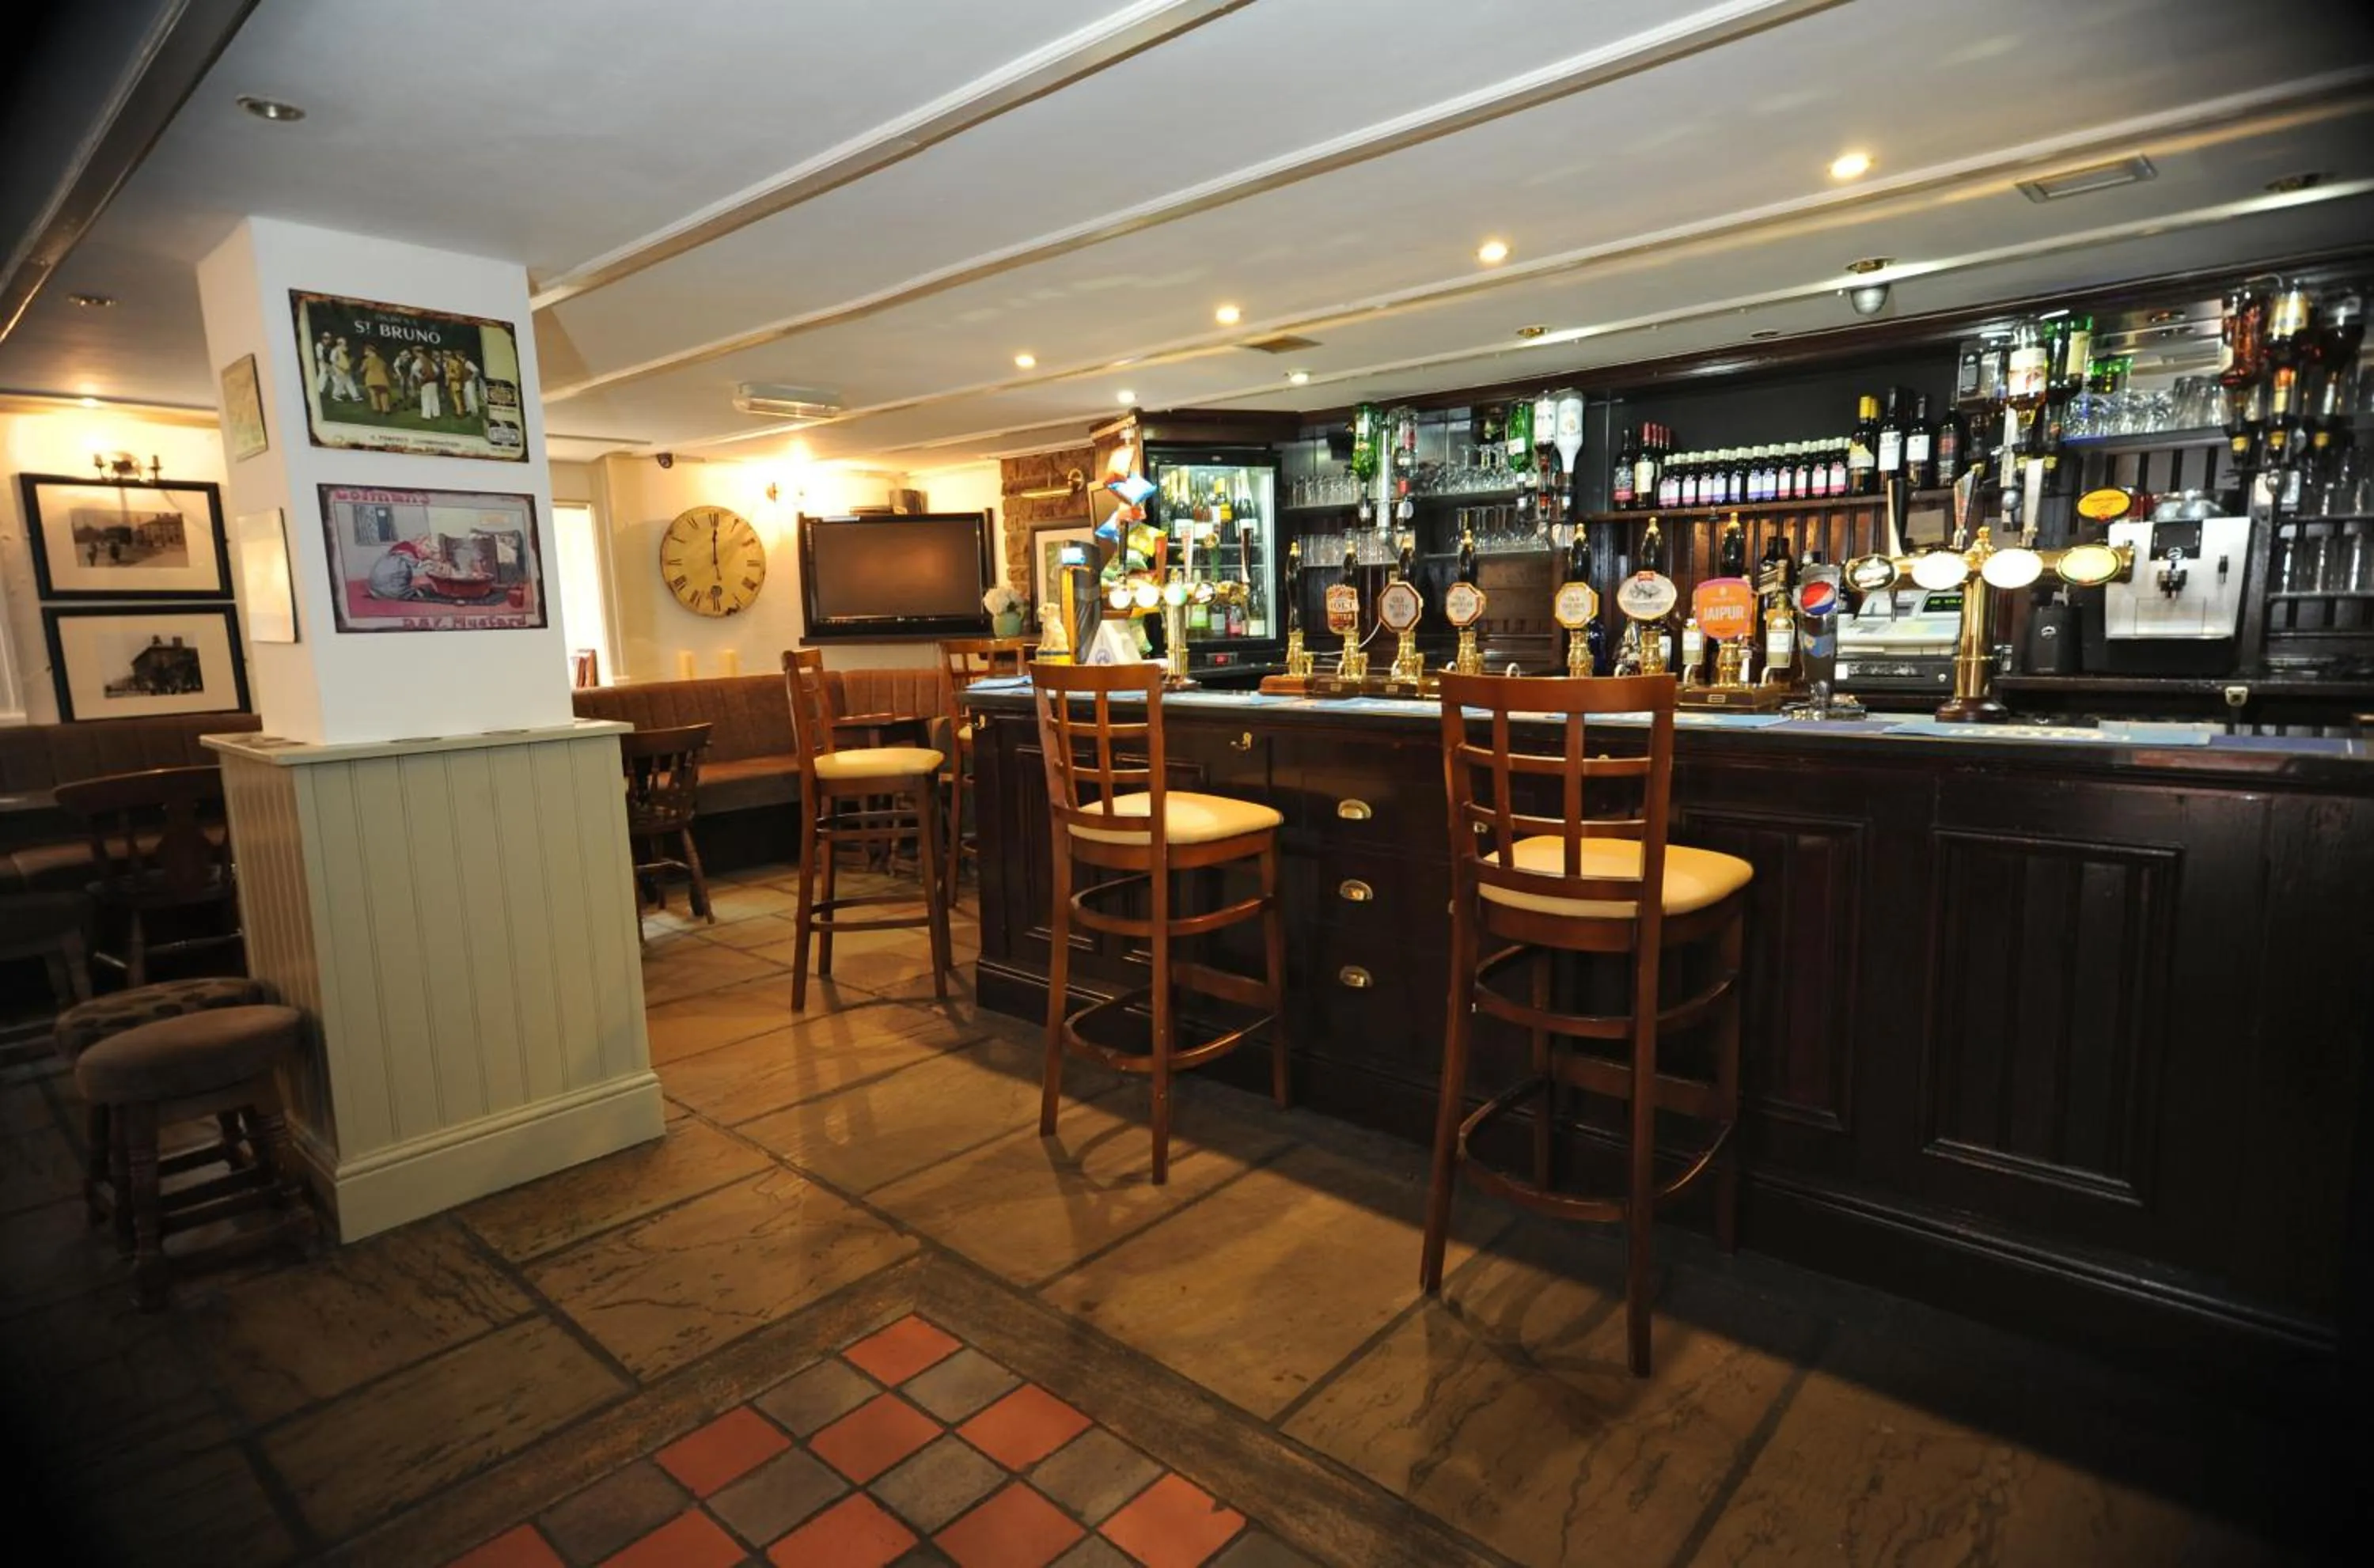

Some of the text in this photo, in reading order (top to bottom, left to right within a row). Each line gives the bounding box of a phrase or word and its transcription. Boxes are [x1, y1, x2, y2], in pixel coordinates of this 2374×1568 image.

[379, 324, 442, 345] BRUNO
[453, 614, 527, 630] Mustard
[1703, 604, 1744, 622] JAIPUR
